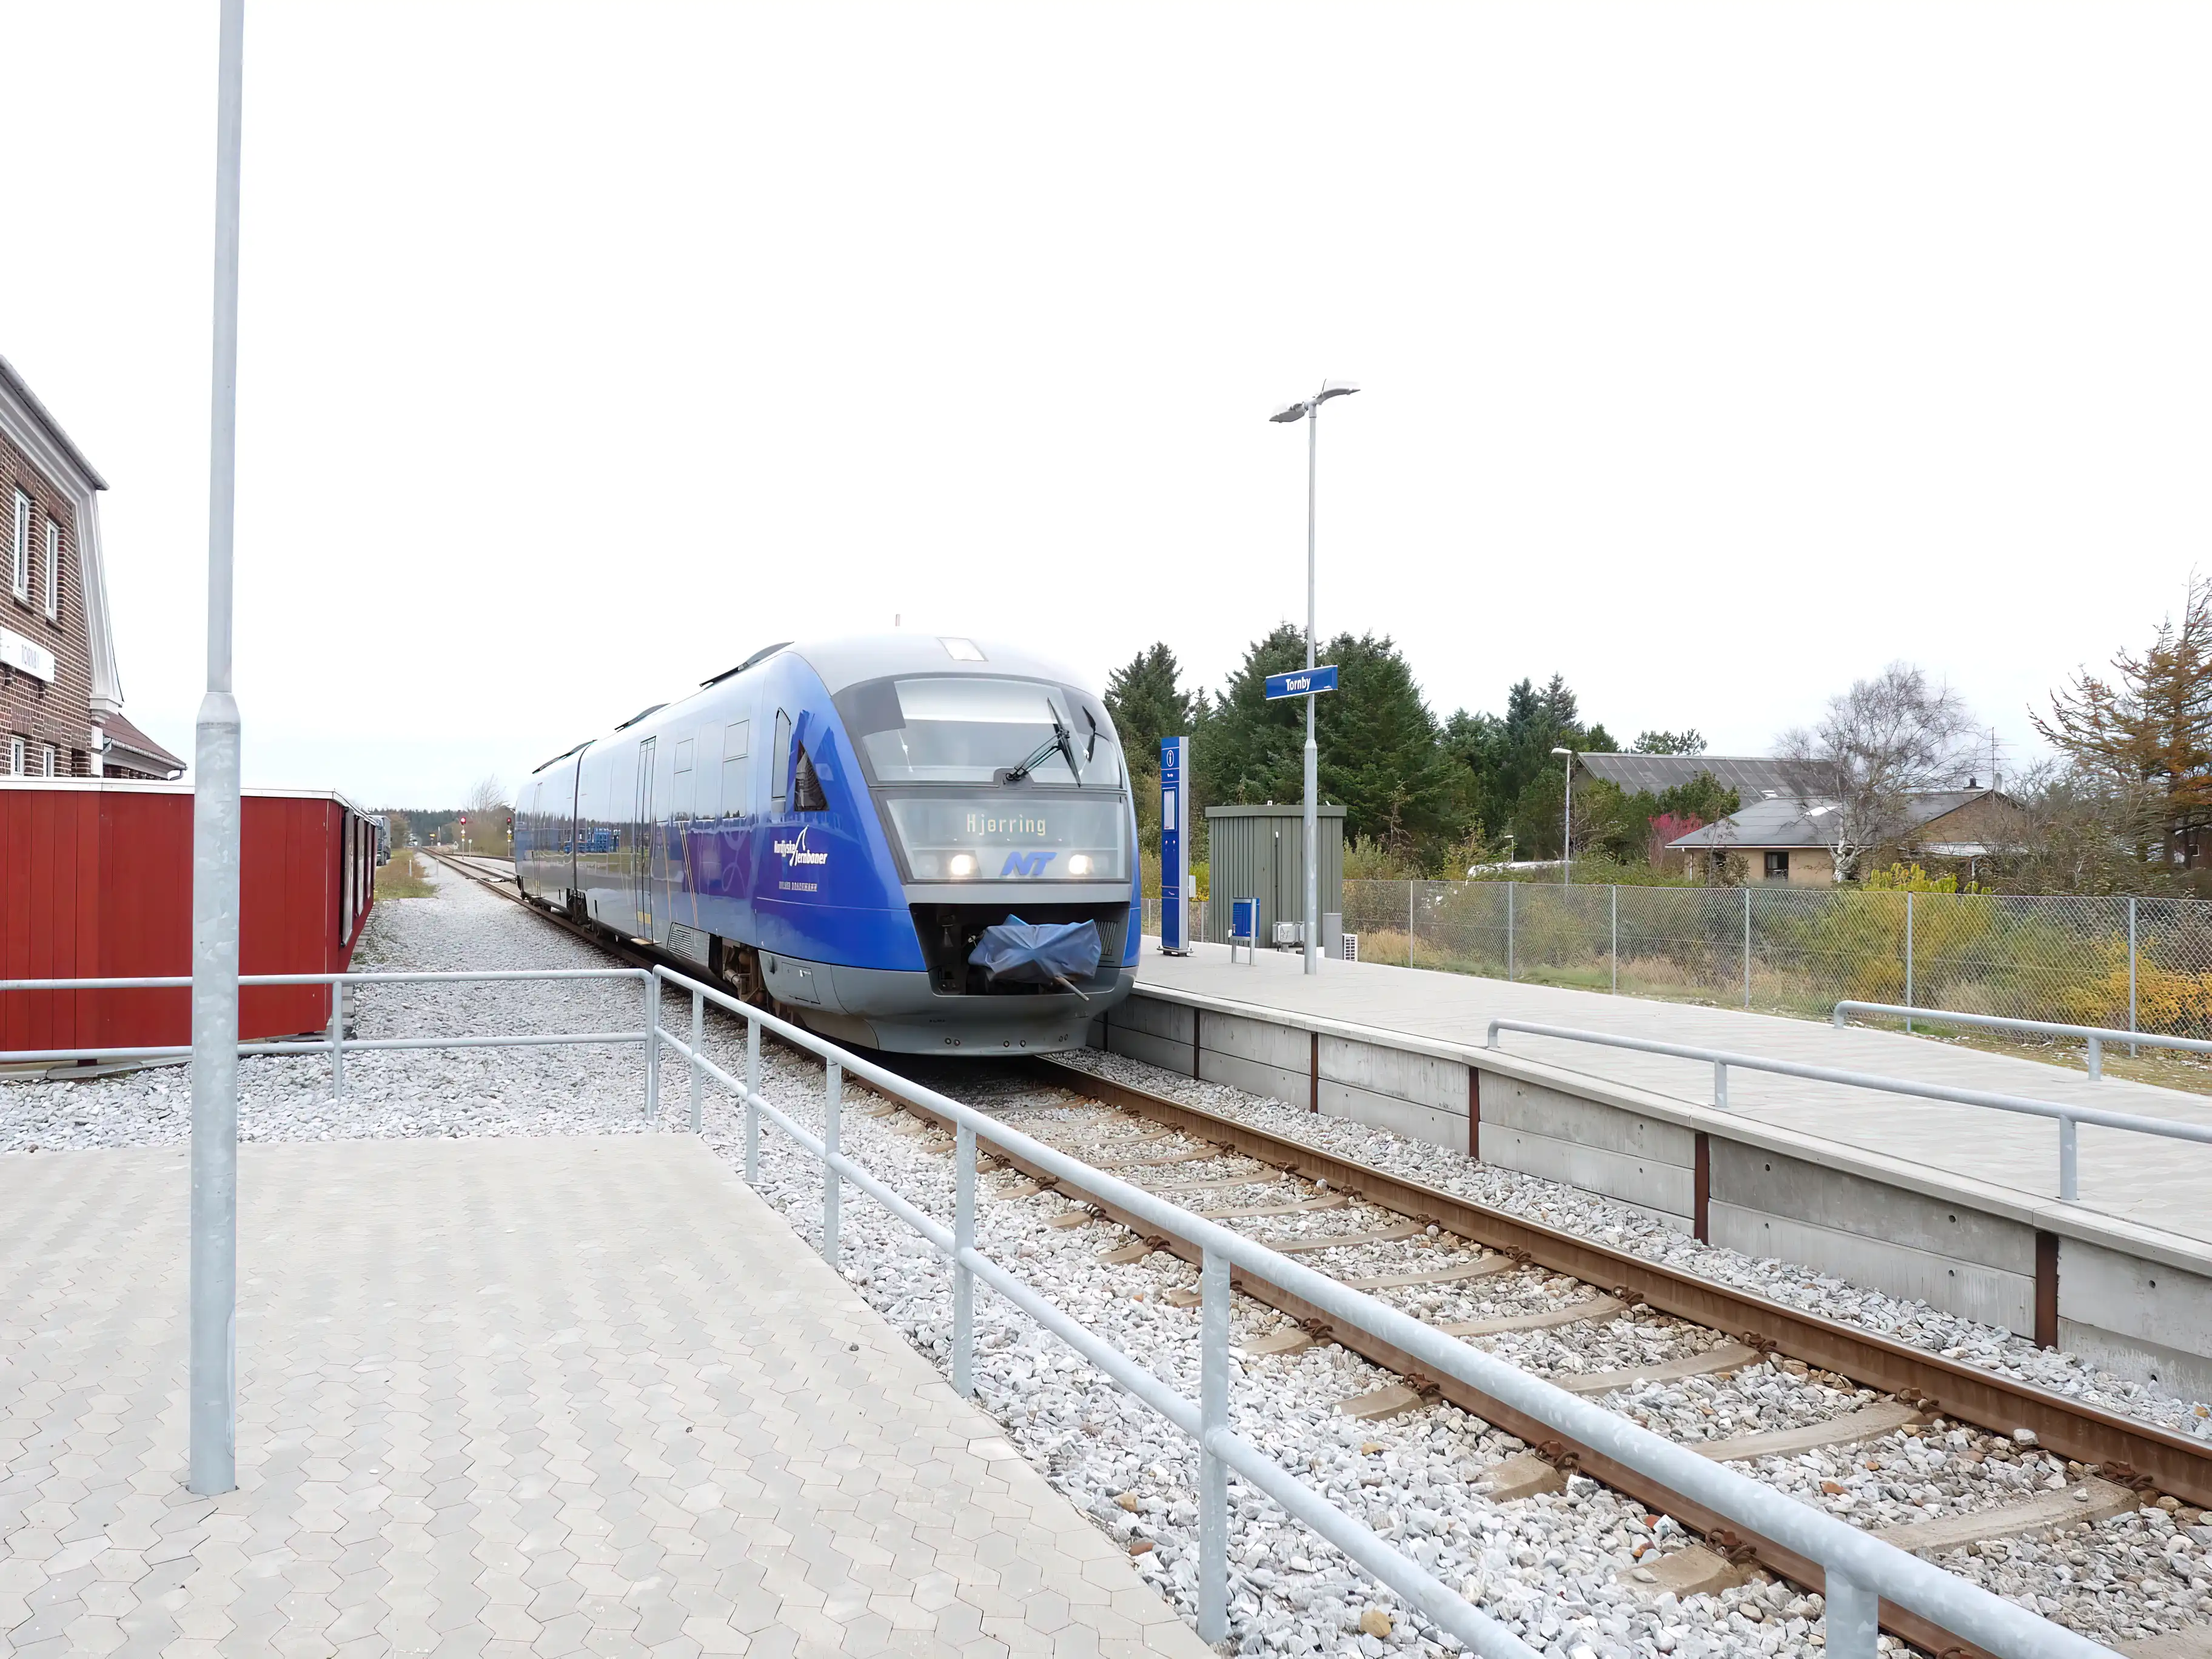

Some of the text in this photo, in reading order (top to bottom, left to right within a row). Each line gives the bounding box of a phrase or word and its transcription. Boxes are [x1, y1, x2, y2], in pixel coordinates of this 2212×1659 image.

[1285, 676, 1311, 691] Tornby
[967, 813, 1046, 836] Hjørring
[1001, 851, 1057, 876] NT
